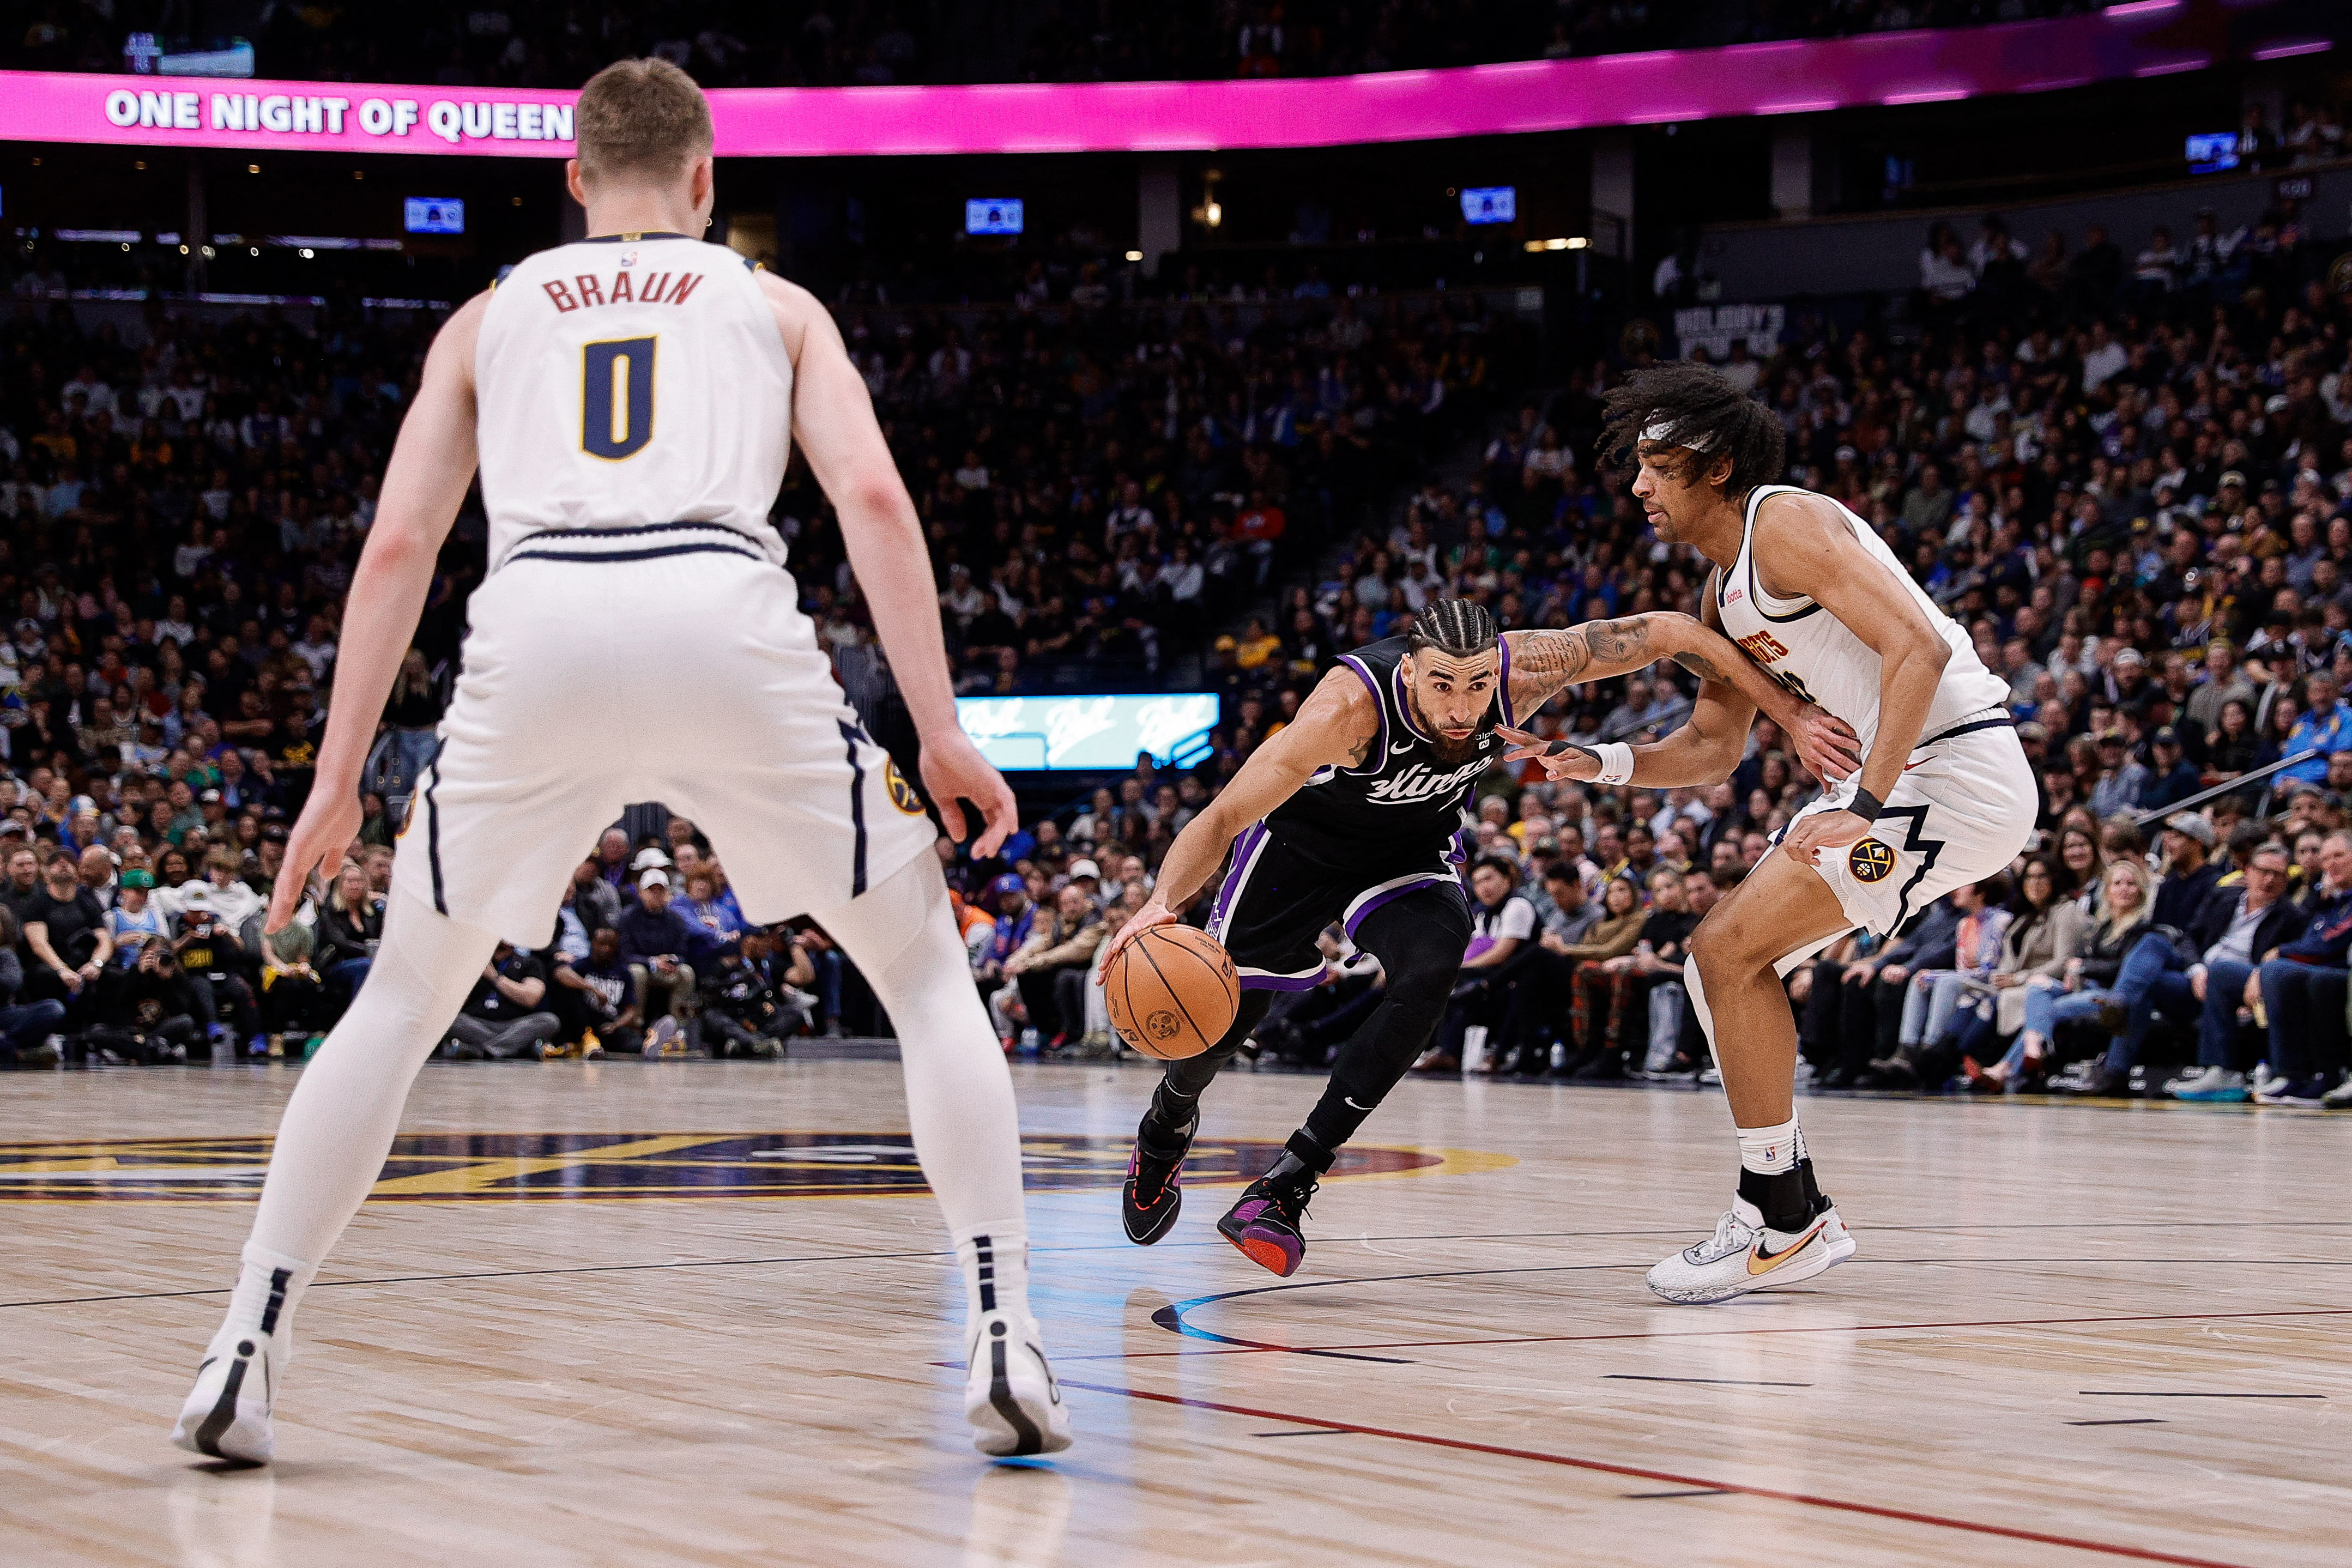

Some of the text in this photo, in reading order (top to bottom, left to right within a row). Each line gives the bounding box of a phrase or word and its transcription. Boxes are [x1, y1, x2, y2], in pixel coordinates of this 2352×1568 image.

[106, 89, 575, 143] ONE NIGHT OF QUEEN
[541, 271, 704, 313] BRAUN
[579, 332, 660, 463] 0
[1725, 589, 1743, 604] ibotta
[1365, 754, 1494, 804] Kings
